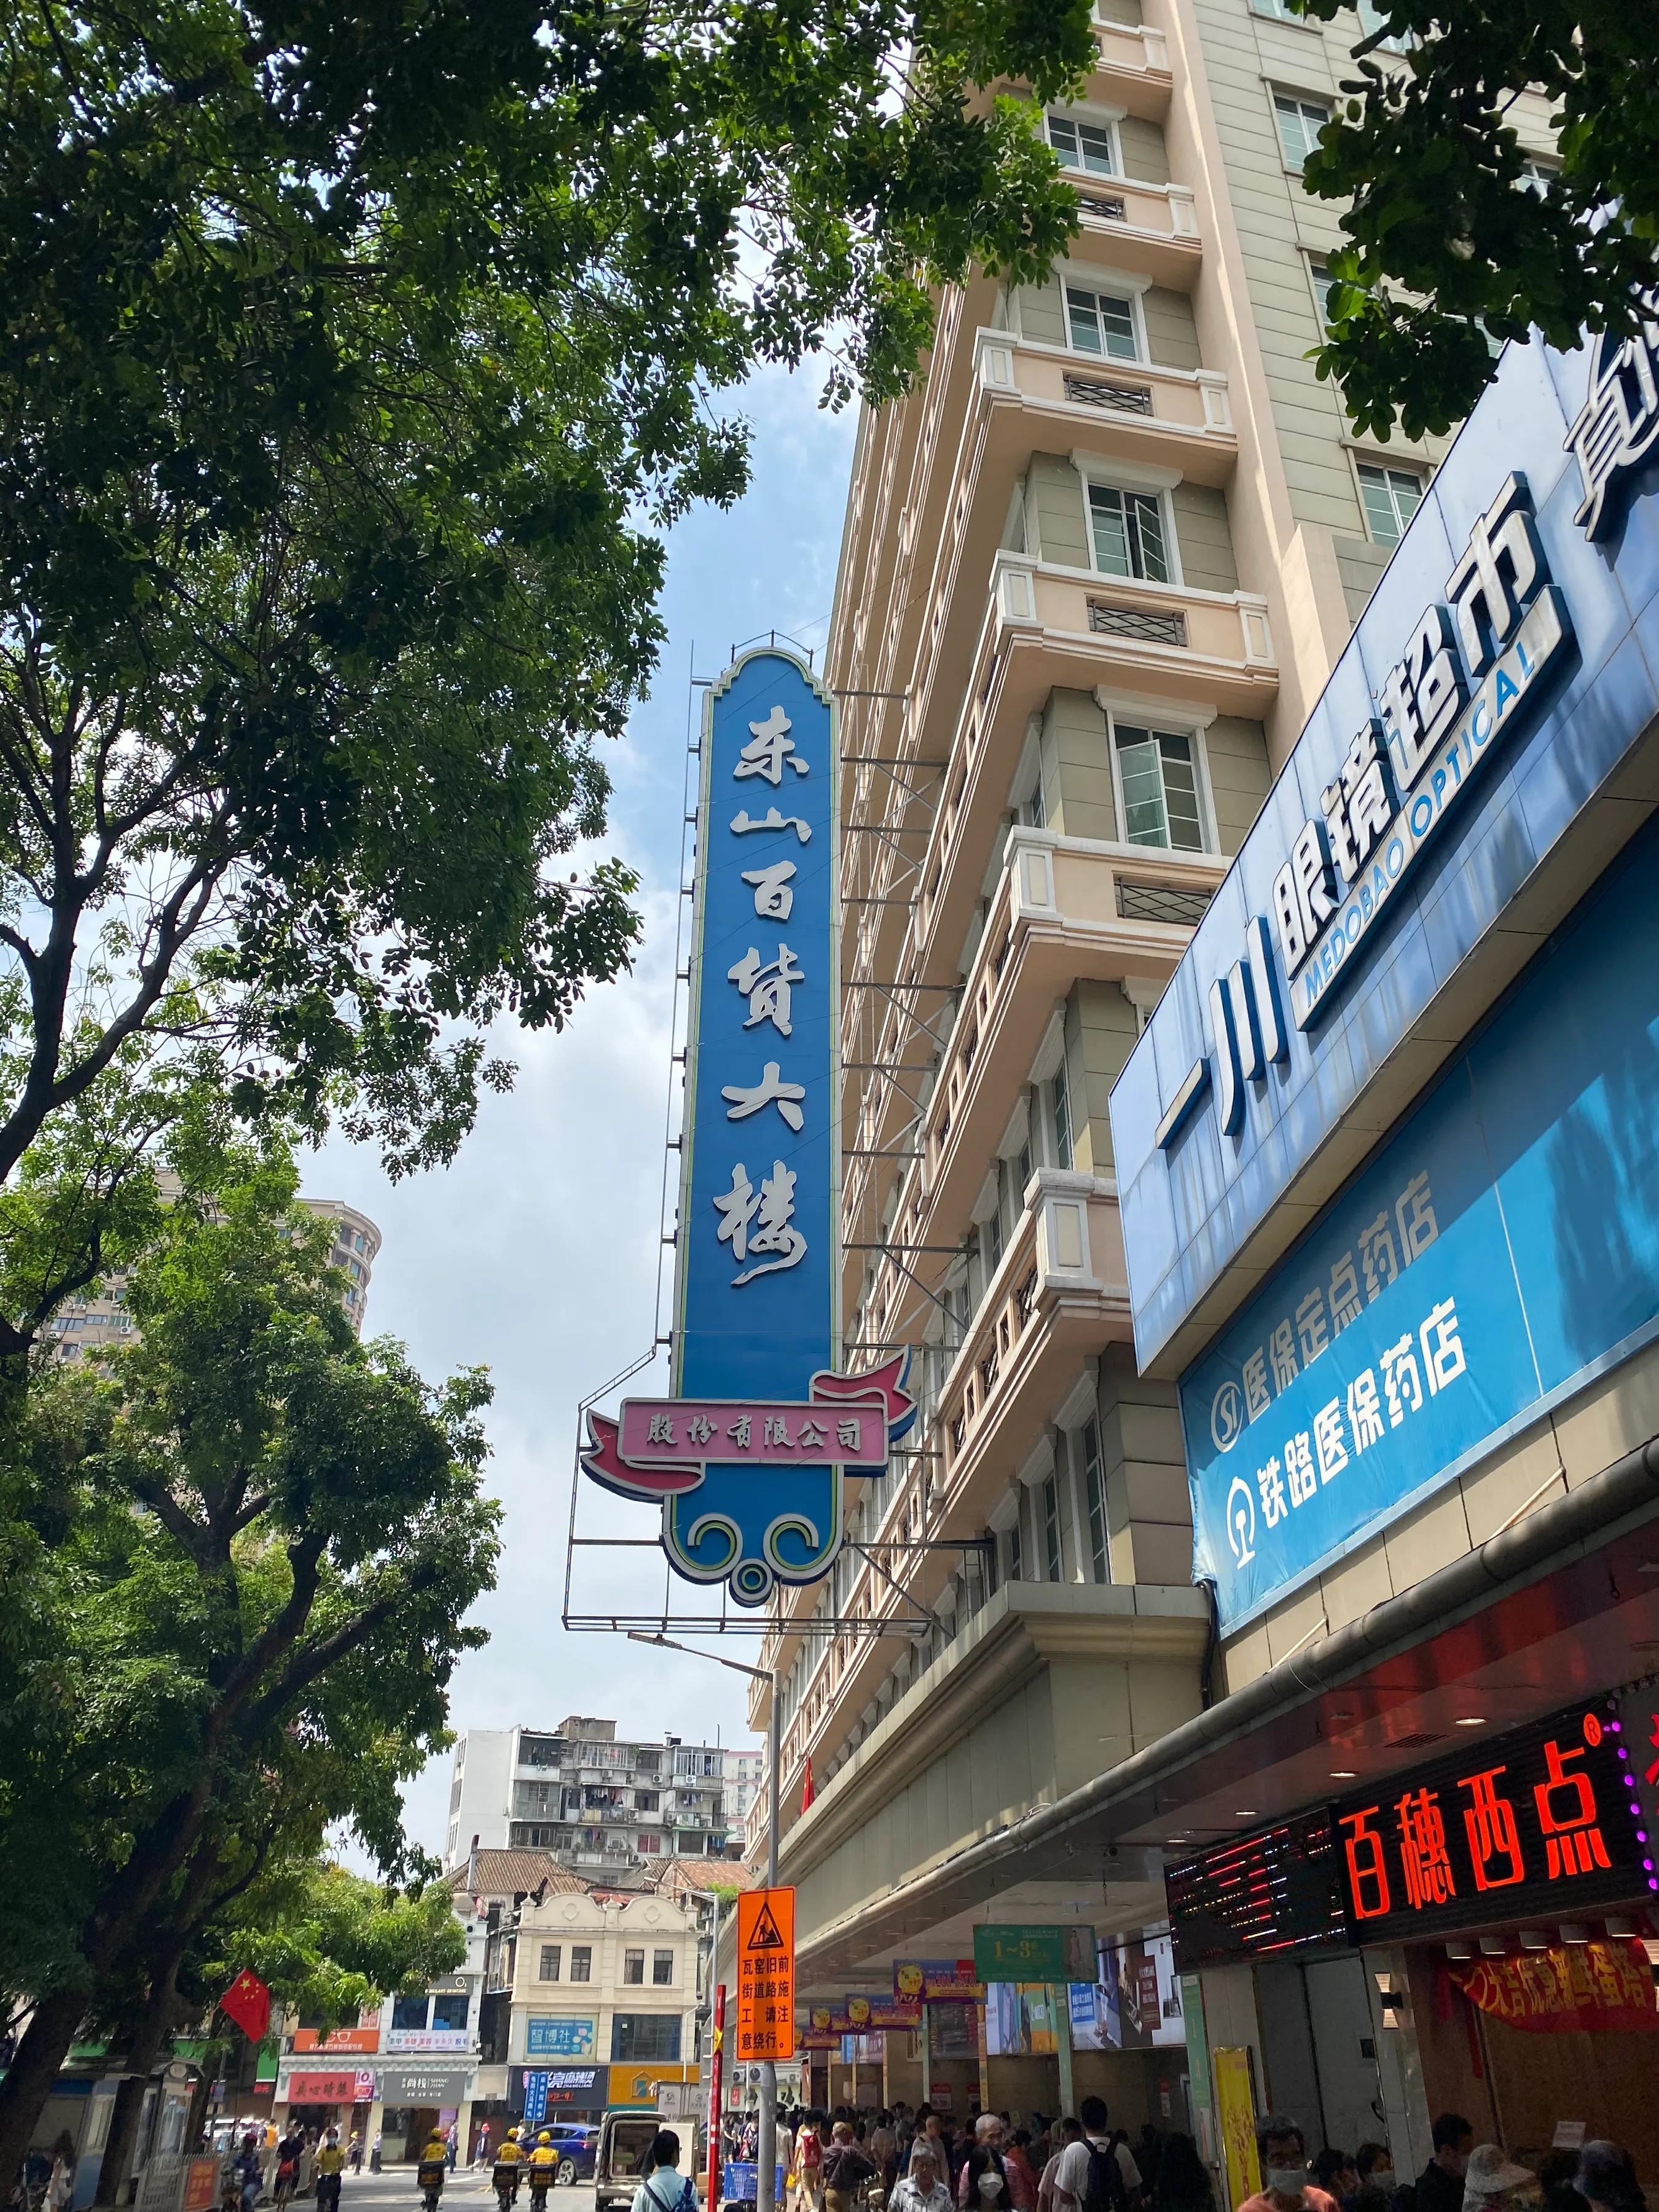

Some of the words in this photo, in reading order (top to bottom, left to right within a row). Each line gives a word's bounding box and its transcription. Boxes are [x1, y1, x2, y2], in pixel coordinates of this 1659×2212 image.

[1304, 837, 1405, 1009] MEDOBAO
[1410, 640, 1537, 838] OPTICAL
[1241, 1169, 1440, 1425] 医保定点药店
[646, 1412, 862, 1451] 股份有限公司
[1257, 1295, 1467, 1529] 铁路医保药店
[1338, 1739, 1612, 1920] 百穗西点
[742, 1955, 790, 1975] 瓦窑旧前
[742, 1980, 790, 2000] 街道路施
[531, 2029, 571, 2044] 智博社
